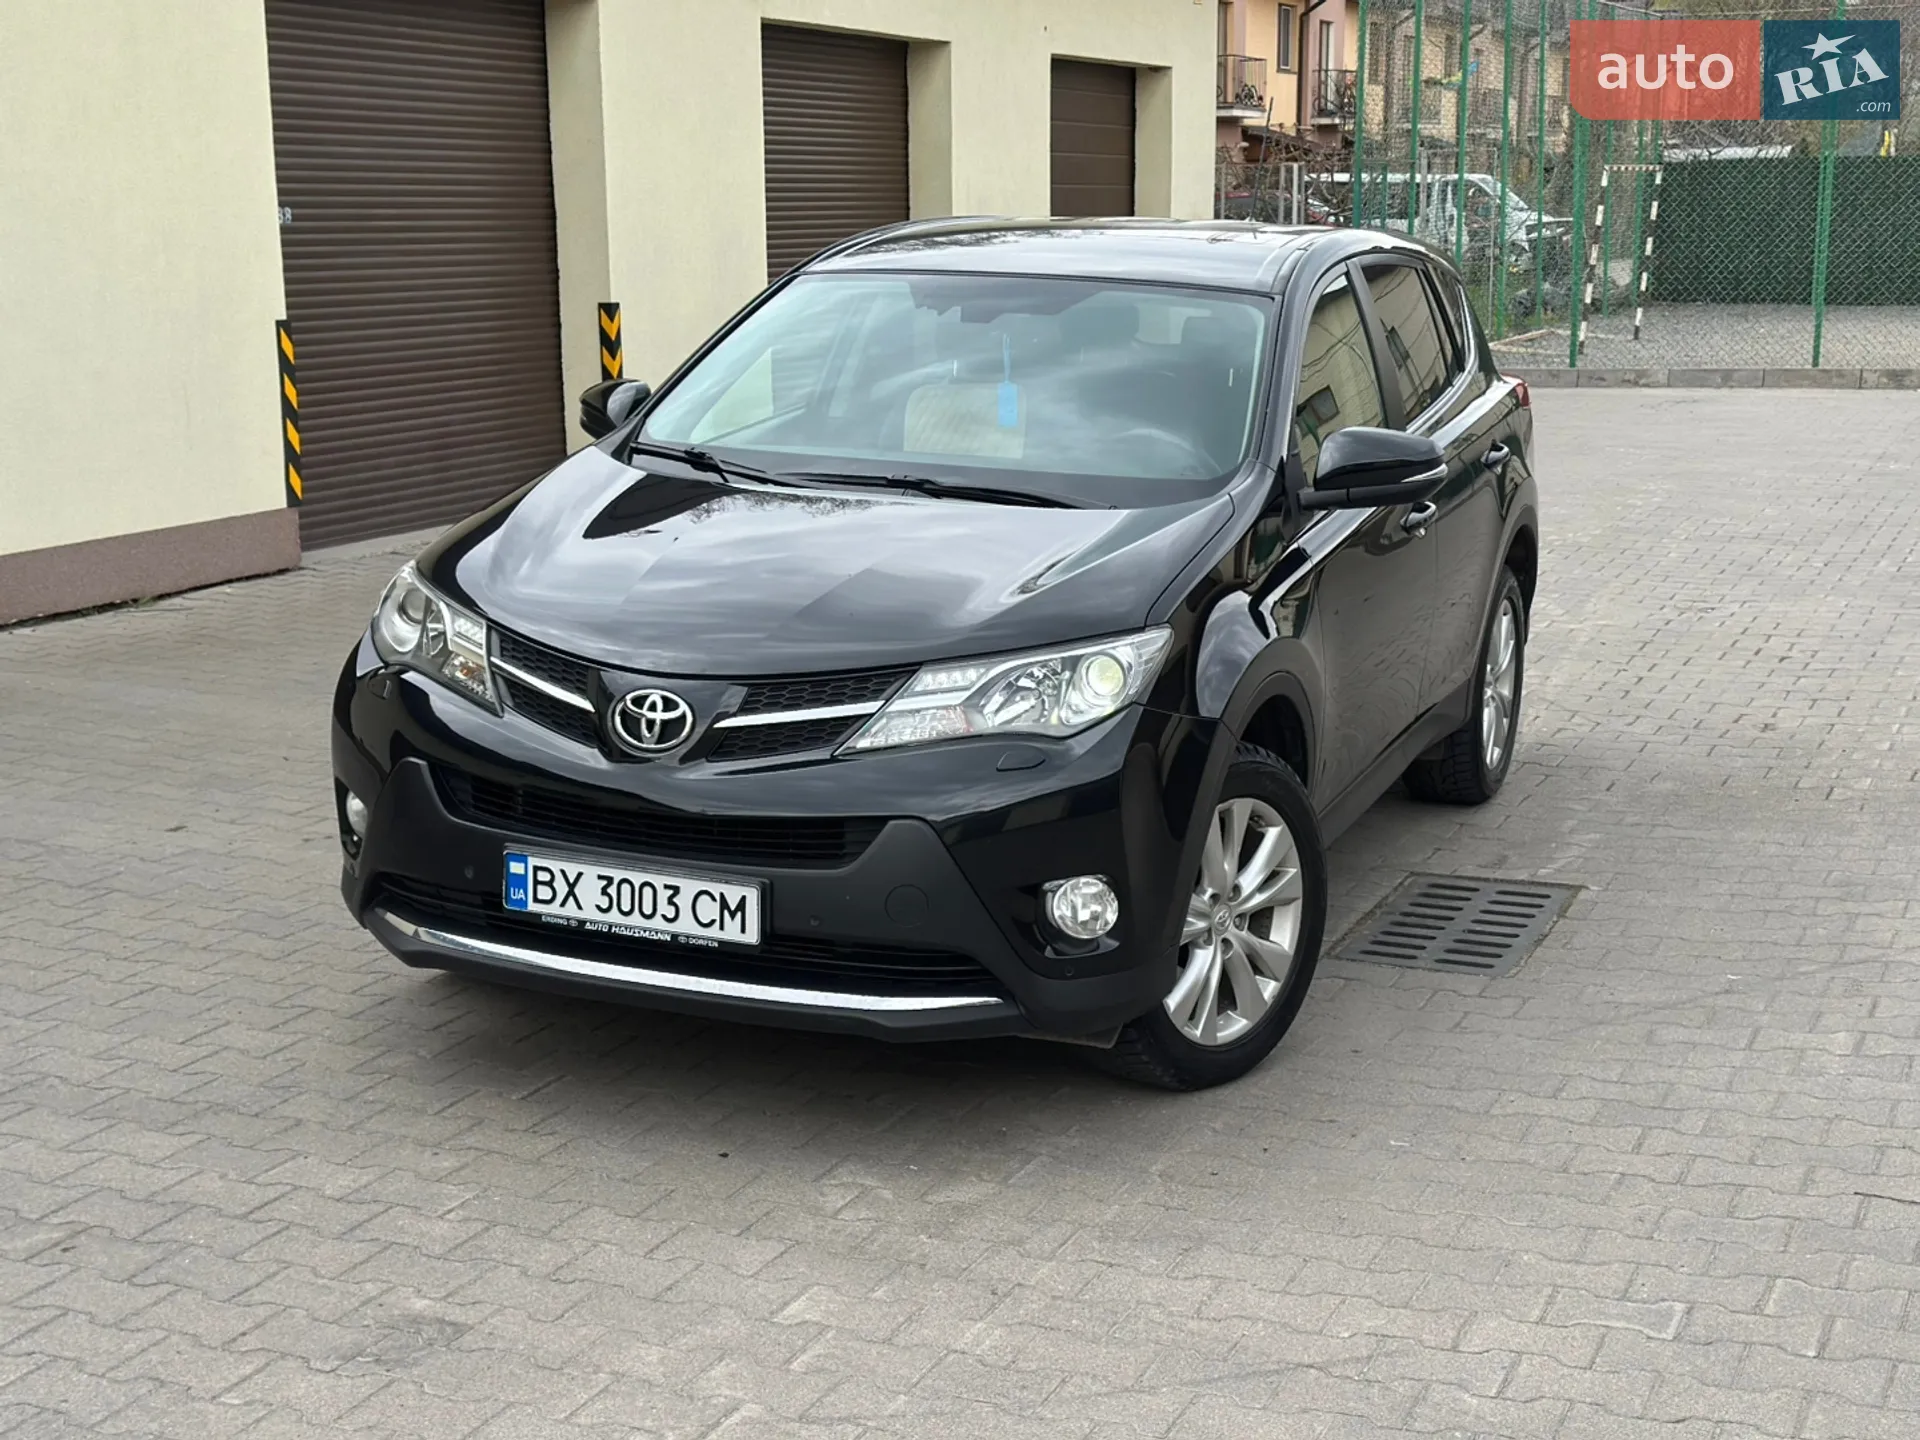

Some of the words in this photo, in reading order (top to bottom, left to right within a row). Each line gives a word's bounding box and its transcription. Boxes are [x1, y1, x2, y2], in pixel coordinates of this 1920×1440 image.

[510, 887, 526, 901] UA
[532, 865, 584, 911] BX
[595, 874, 681, 924] 3003
[691, 889, 747, 935] CM
[541, 915, 568, 926] ERDING
[584, 921, 609, 933] AUTO
[611, 925, 672, 942] HAUSMANN
